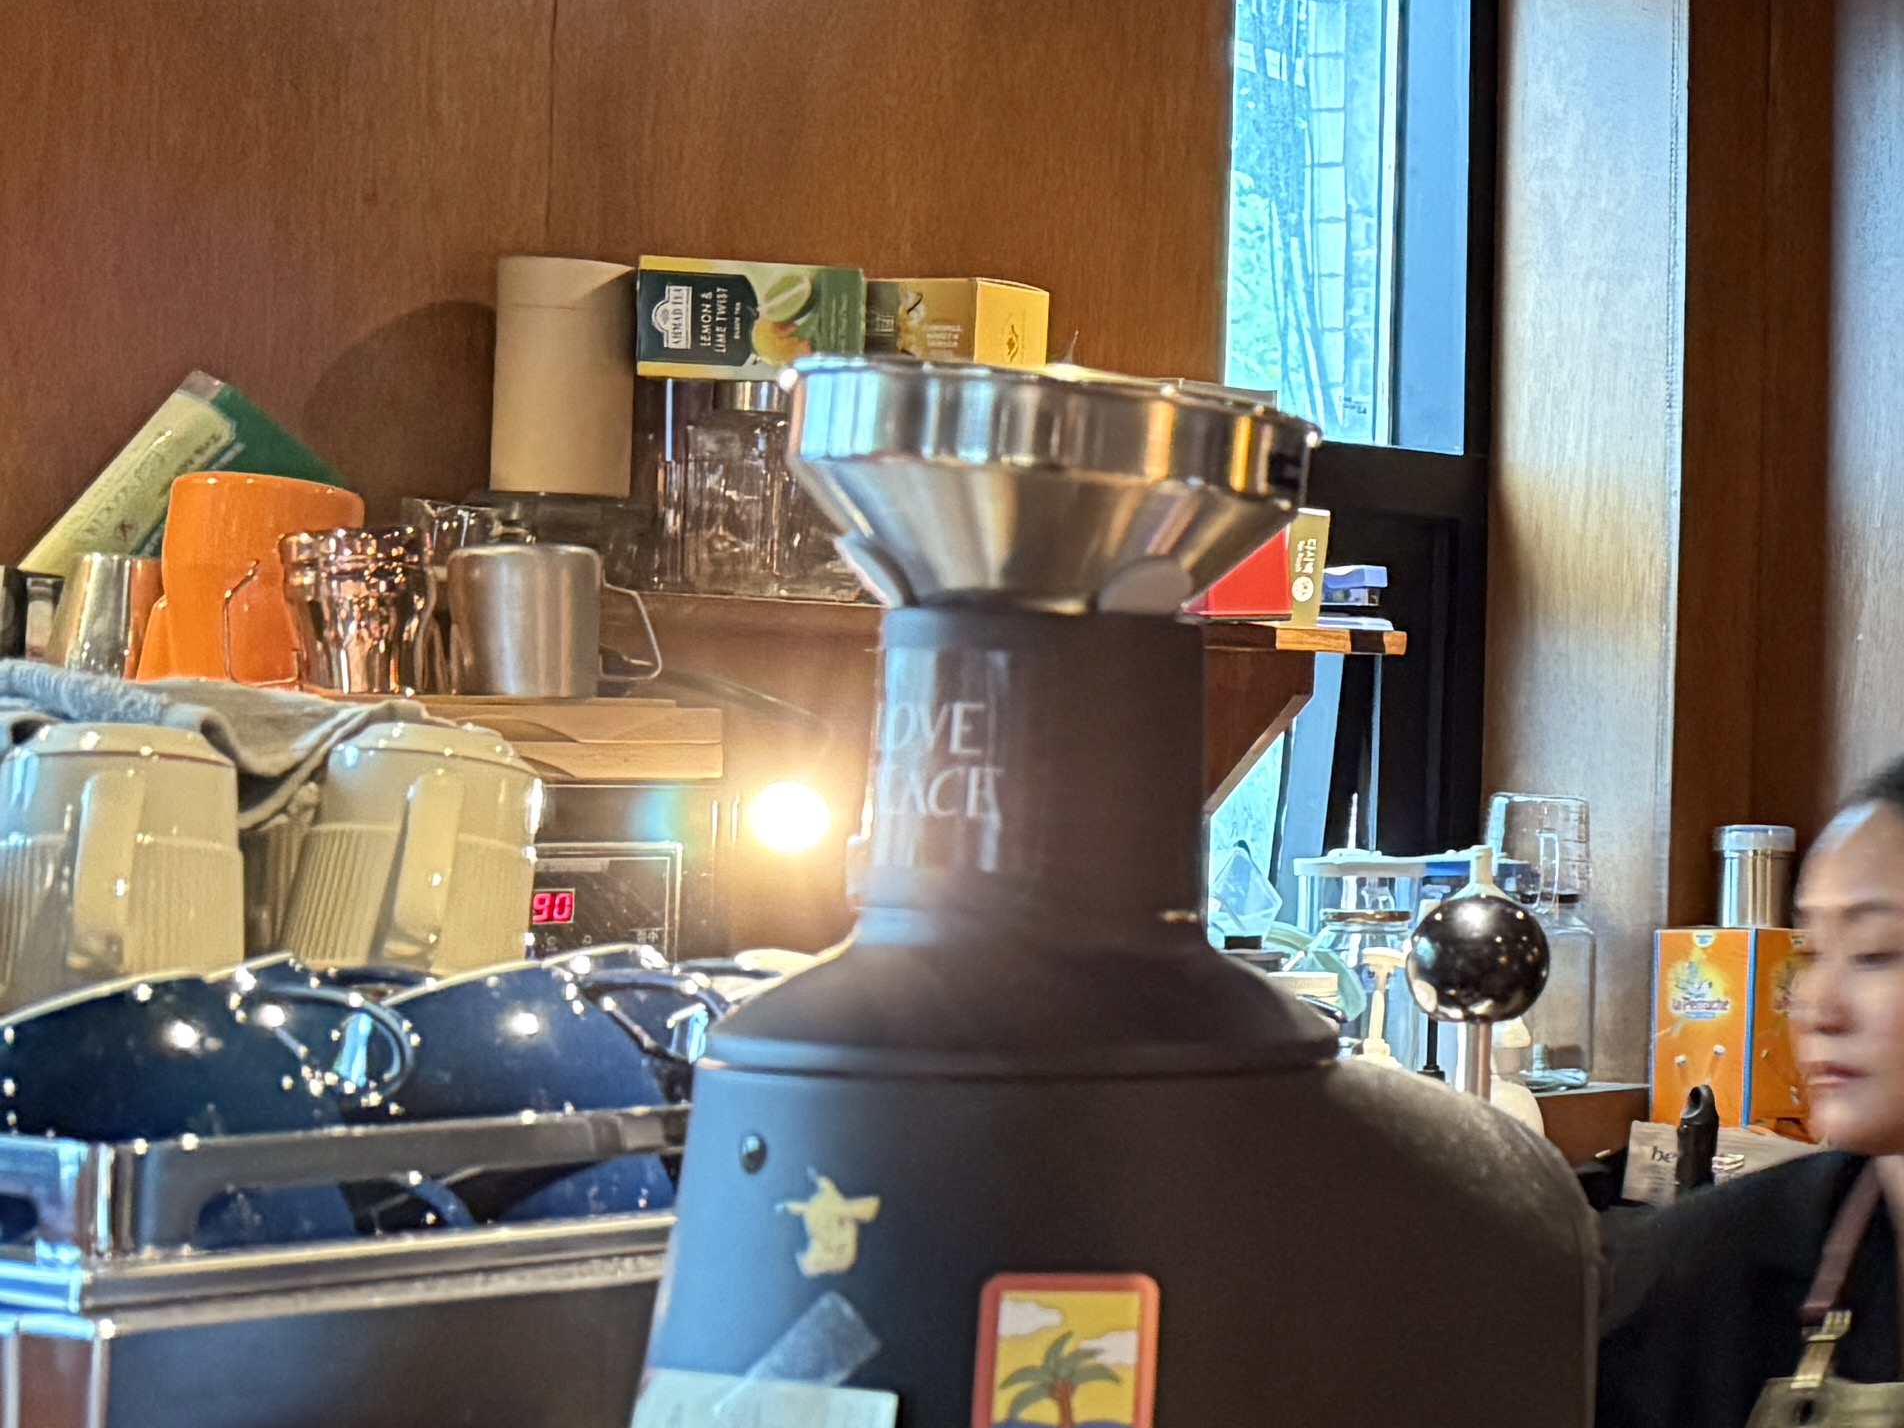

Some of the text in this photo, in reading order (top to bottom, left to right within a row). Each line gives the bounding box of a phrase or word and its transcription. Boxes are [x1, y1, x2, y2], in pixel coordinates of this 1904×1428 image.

[671, 306, 683, 346] AHMAD
[699, 302, 712, 347] LEMON
[713, 286, 729, 353] LIME TWIST
